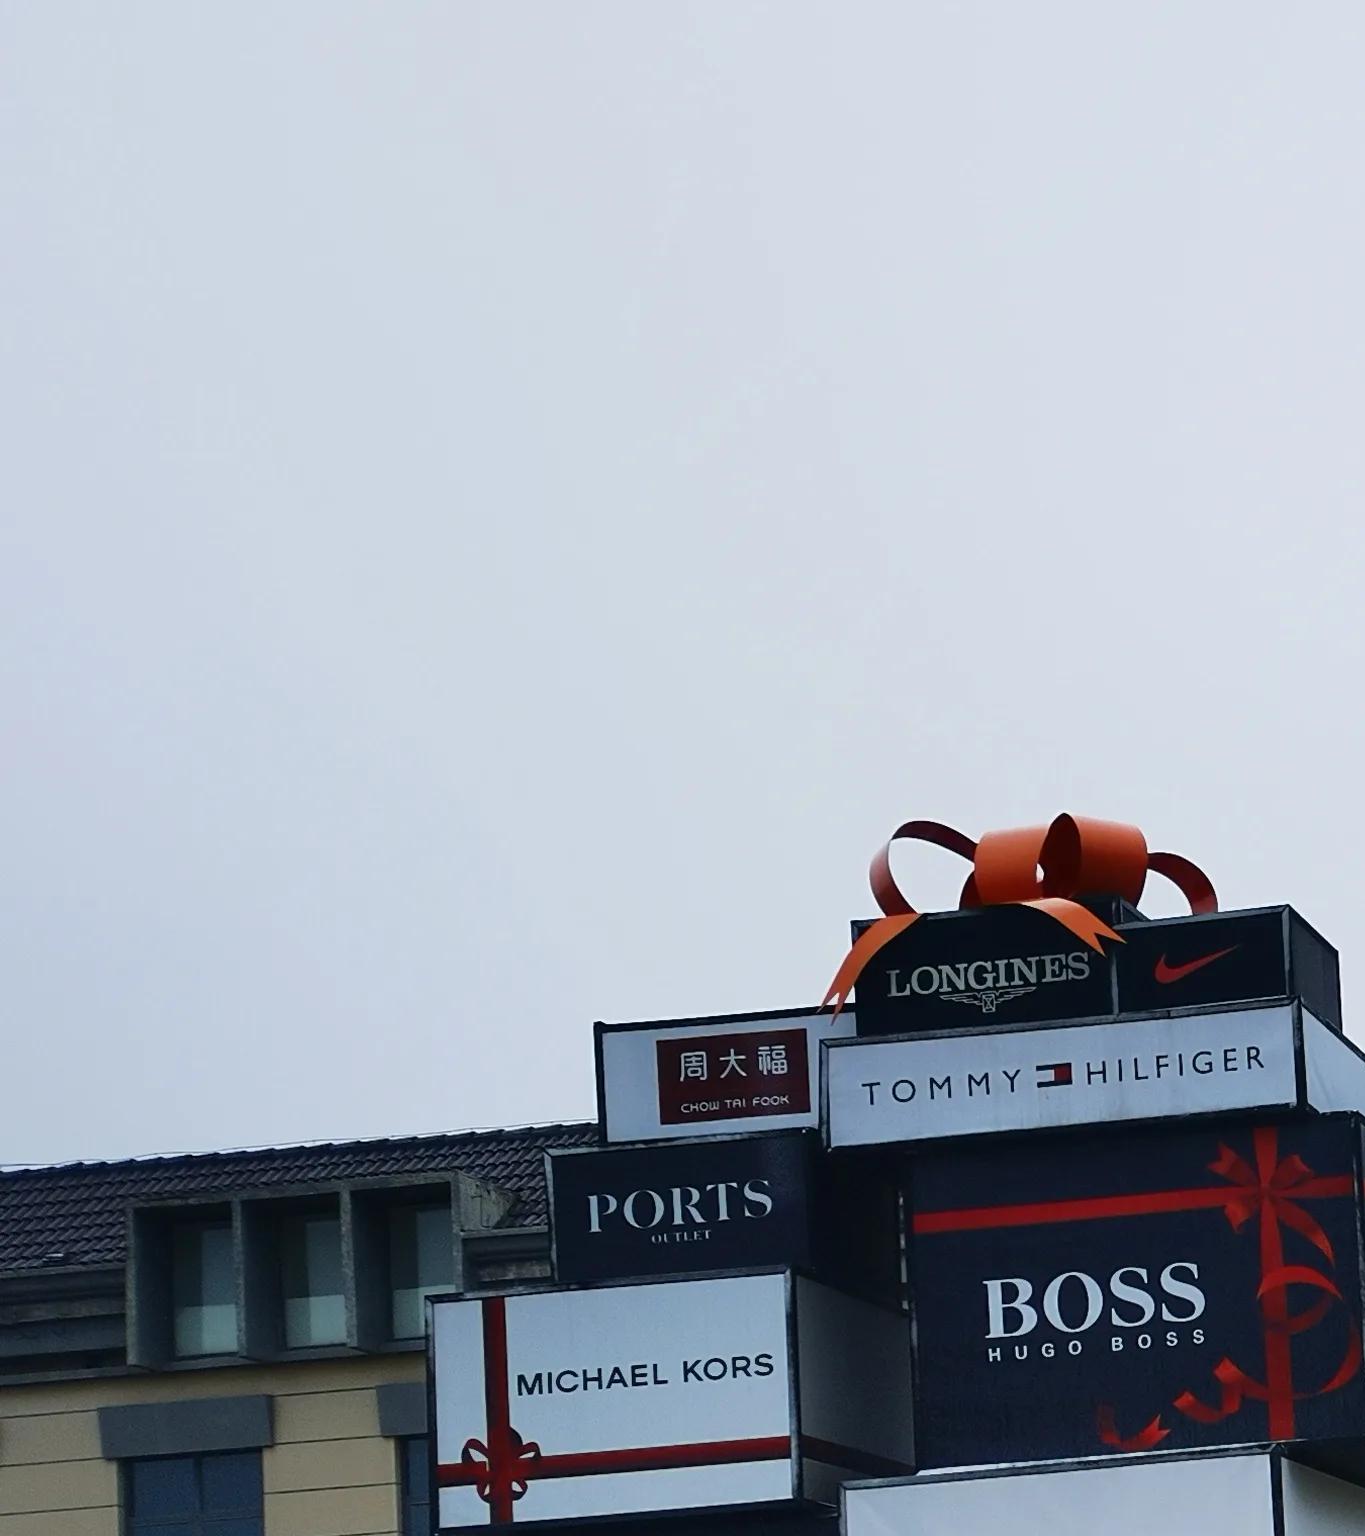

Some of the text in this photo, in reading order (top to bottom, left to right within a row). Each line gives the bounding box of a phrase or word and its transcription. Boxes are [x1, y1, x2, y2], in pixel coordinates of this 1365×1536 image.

[887, 951, 1090, 999] LONGINES
[680, 1045, 788, 1082] 周大福
[862, 1045, 1265, 1106] TOMMY HILFIGER
[681, 1095, 790, 1113] CHOW TAI FOOK
[587, 1179, 773, 1233] PORTS
[651, 1229, 712, 1244] OUTLET
[982, 1261, 1206, 1340] BOSS
[988, 1328, 1206, 1362] HUGO BOSS
[516, 1353, 774, 1396] MICHAEL KORS
